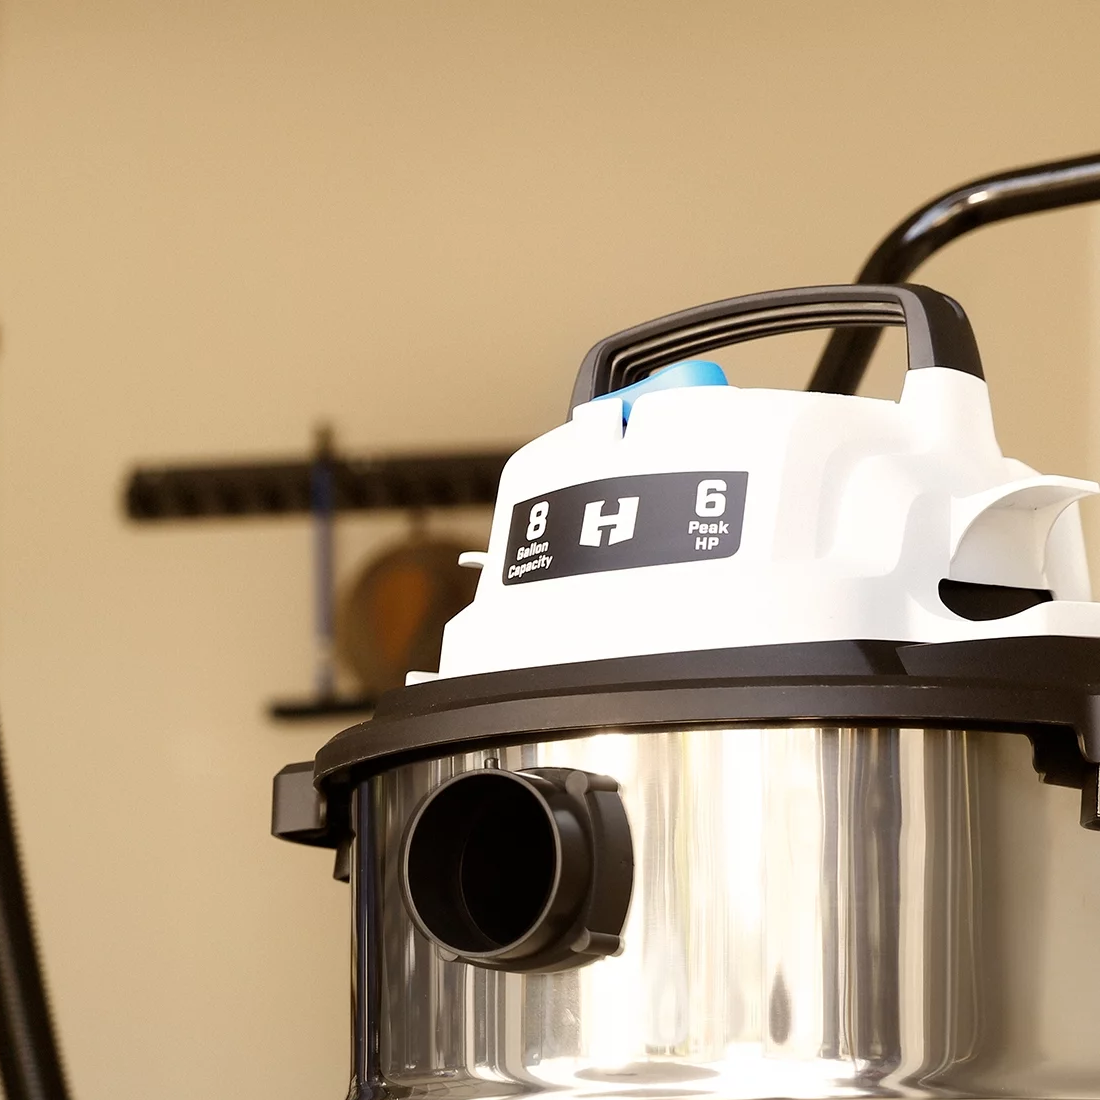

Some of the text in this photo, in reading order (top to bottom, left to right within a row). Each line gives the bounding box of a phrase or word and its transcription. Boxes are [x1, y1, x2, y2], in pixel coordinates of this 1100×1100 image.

[695, 479, 728, 518] 6
[526, 500, 550, 541] 8
[579, 496, 640, 547] H
[688, 520, 729, 535] Peak
[516, 541, 549, 561] Gallon
[695, 536, 720, 551] HP
[508, 554, 553, 579] Capacity
